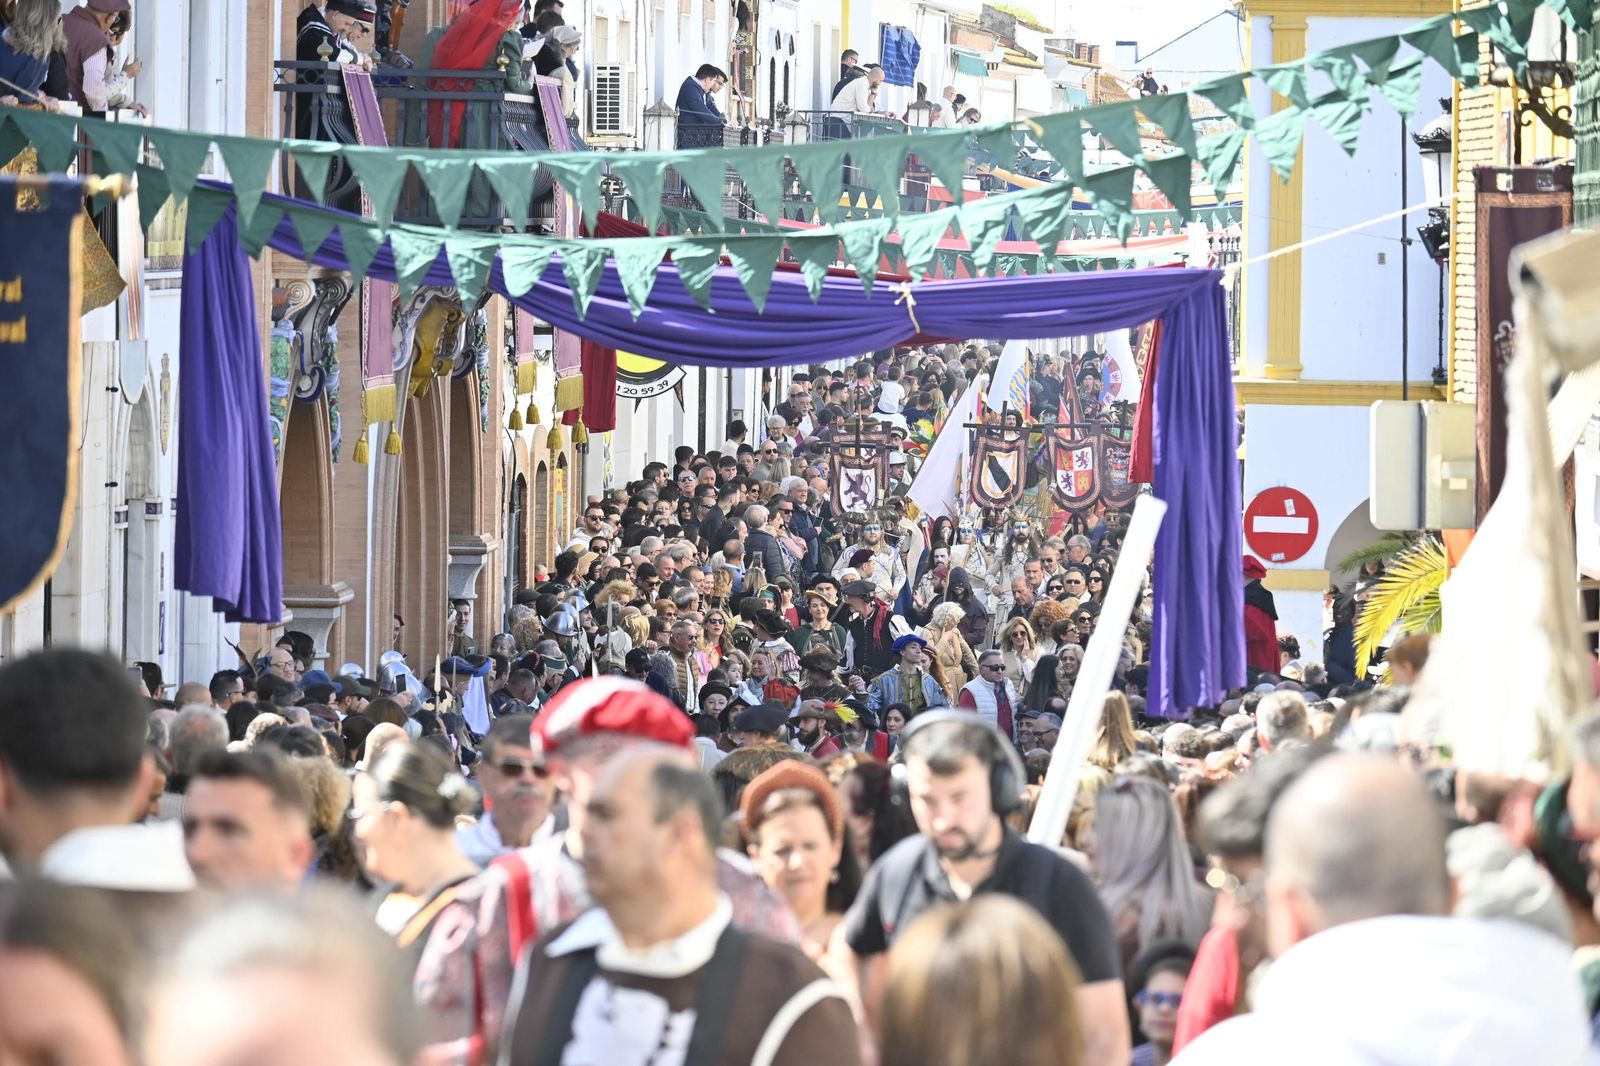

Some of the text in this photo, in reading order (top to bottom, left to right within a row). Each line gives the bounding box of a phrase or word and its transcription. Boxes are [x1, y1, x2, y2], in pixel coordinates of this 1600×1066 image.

[623, 387, 638, 395] 20
[641, 386, 654, 395] 59
[657, 379, 669, 391] 39
